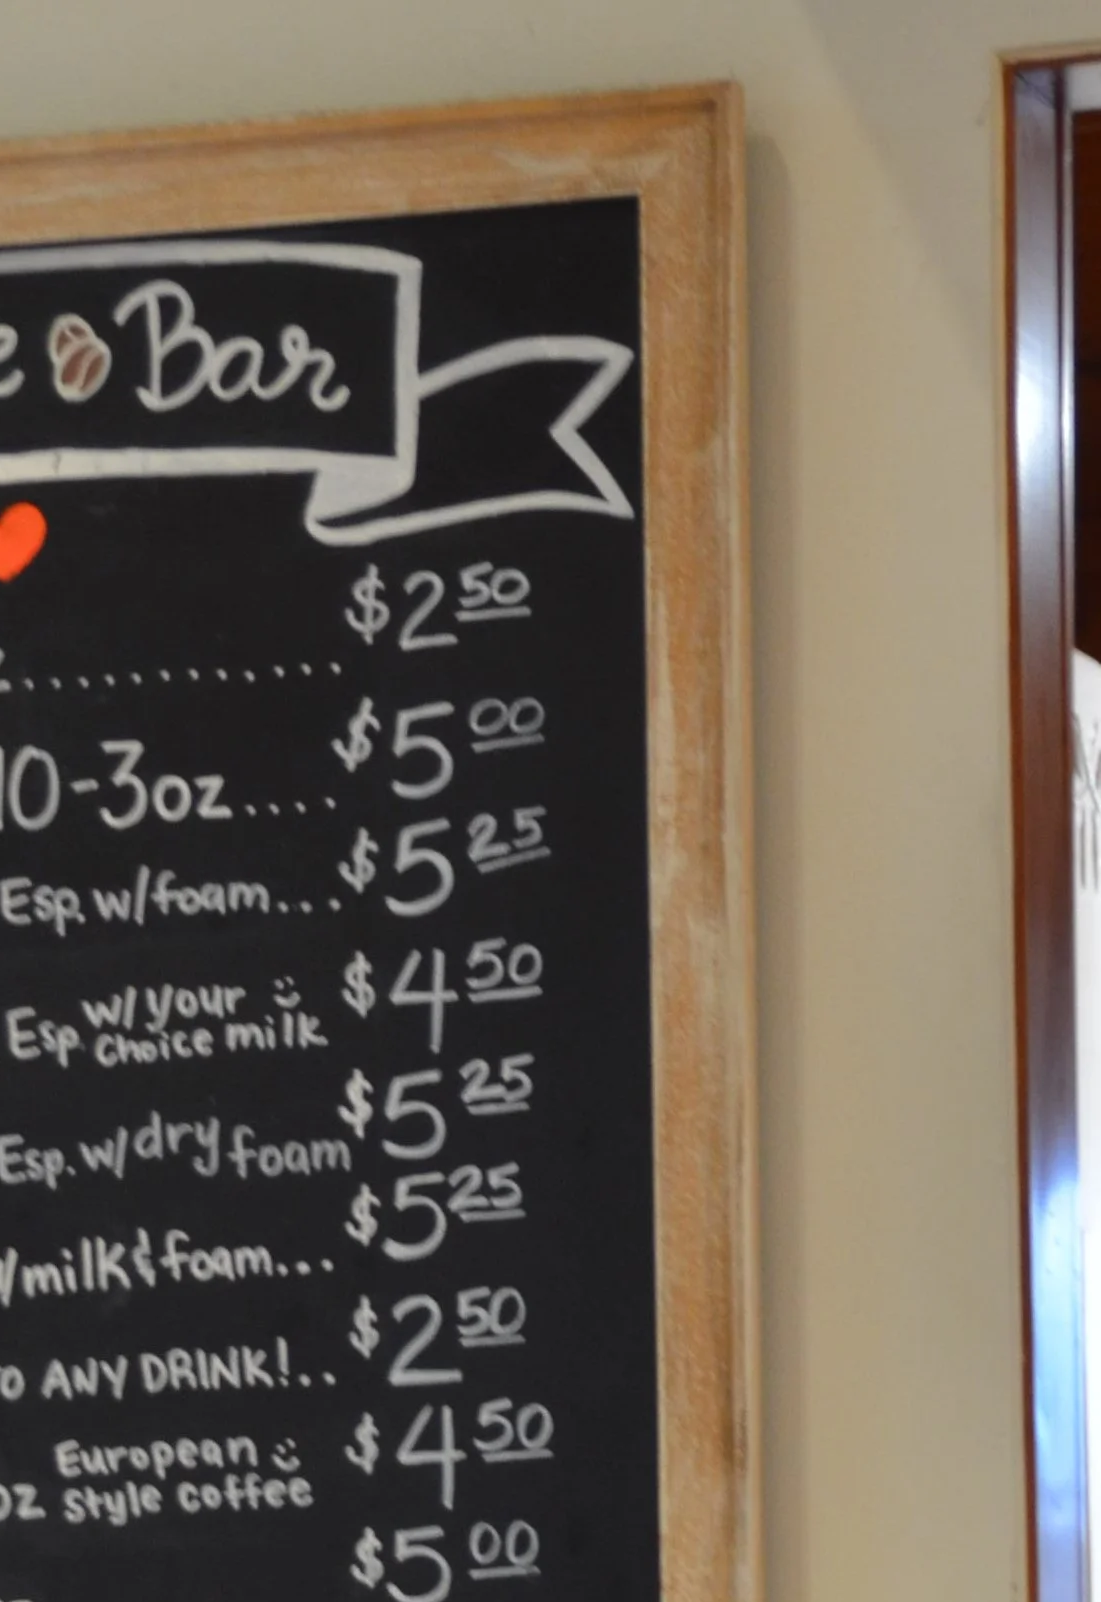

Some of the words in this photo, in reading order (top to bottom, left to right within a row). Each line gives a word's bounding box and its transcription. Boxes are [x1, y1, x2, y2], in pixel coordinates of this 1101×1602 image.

[113, 279, 350, 411] Bar
[225, 1012, 329, 1051] milk
[227, 1124, 350, 1179] foam
[41, 1354, 129, 1400] ANY
[54, 1436, 259, 1479] European
[62, 1480, 163, 1526] style
[176, 1474, 314, 1514] coffee
